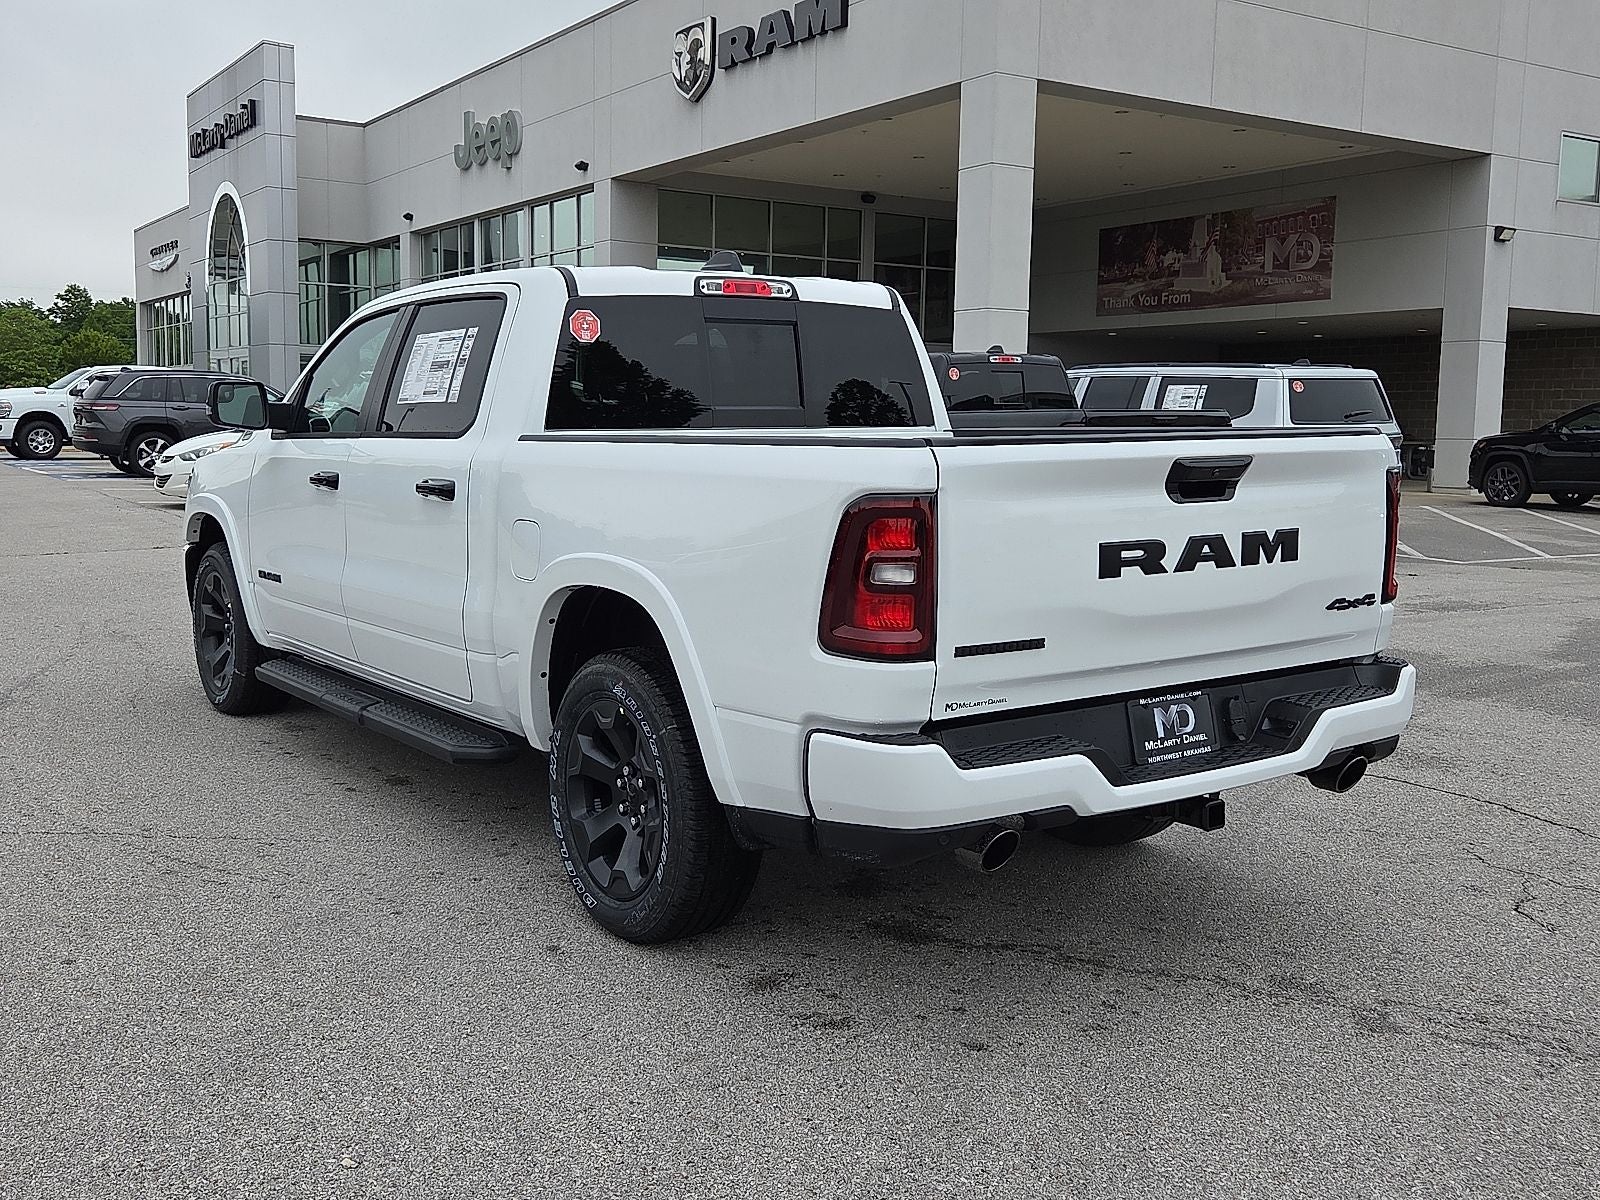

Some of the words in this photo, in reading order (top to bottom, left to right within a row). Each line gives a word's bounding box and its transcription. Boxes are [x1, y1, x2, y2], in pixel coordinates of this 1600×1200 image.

[718, 0, 849, 70] RAM
[454, 110, 523, 170] Jeep
[1103, 297, 1134, 310] Thank
[1138, 294, 1158, 306] You
[1162, 291, 1191, 305] From
[1098, 528, 1300, 579] RAM
[1148, 751, 1183, 763] NORTHWEST
[1183, 746, 1212, 757] ARKANSAS
